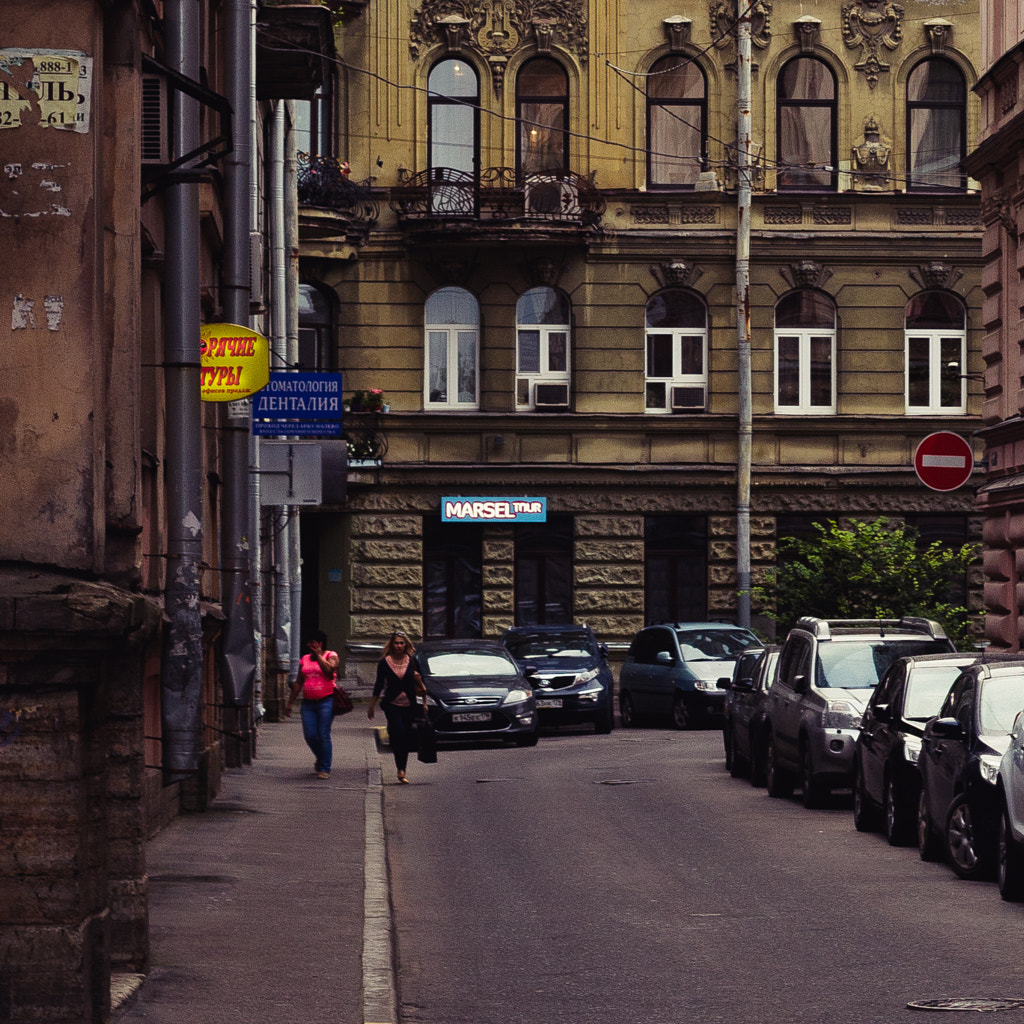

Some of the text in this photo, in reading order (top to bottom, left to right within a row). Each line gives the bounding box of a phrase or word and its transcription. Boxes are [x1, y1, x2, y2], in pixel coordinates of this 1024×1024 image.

[200, 337, 257, 357] РЯЧИЕ
[200, 366, 243, 386] ТУРЫ
[261, 380, 338, 392] ТОМАТОЛОГИЯ
[257, 396, 339, 411] ДЕНТАЛИЯ
[445, 501, 517, 519] MARSEL
